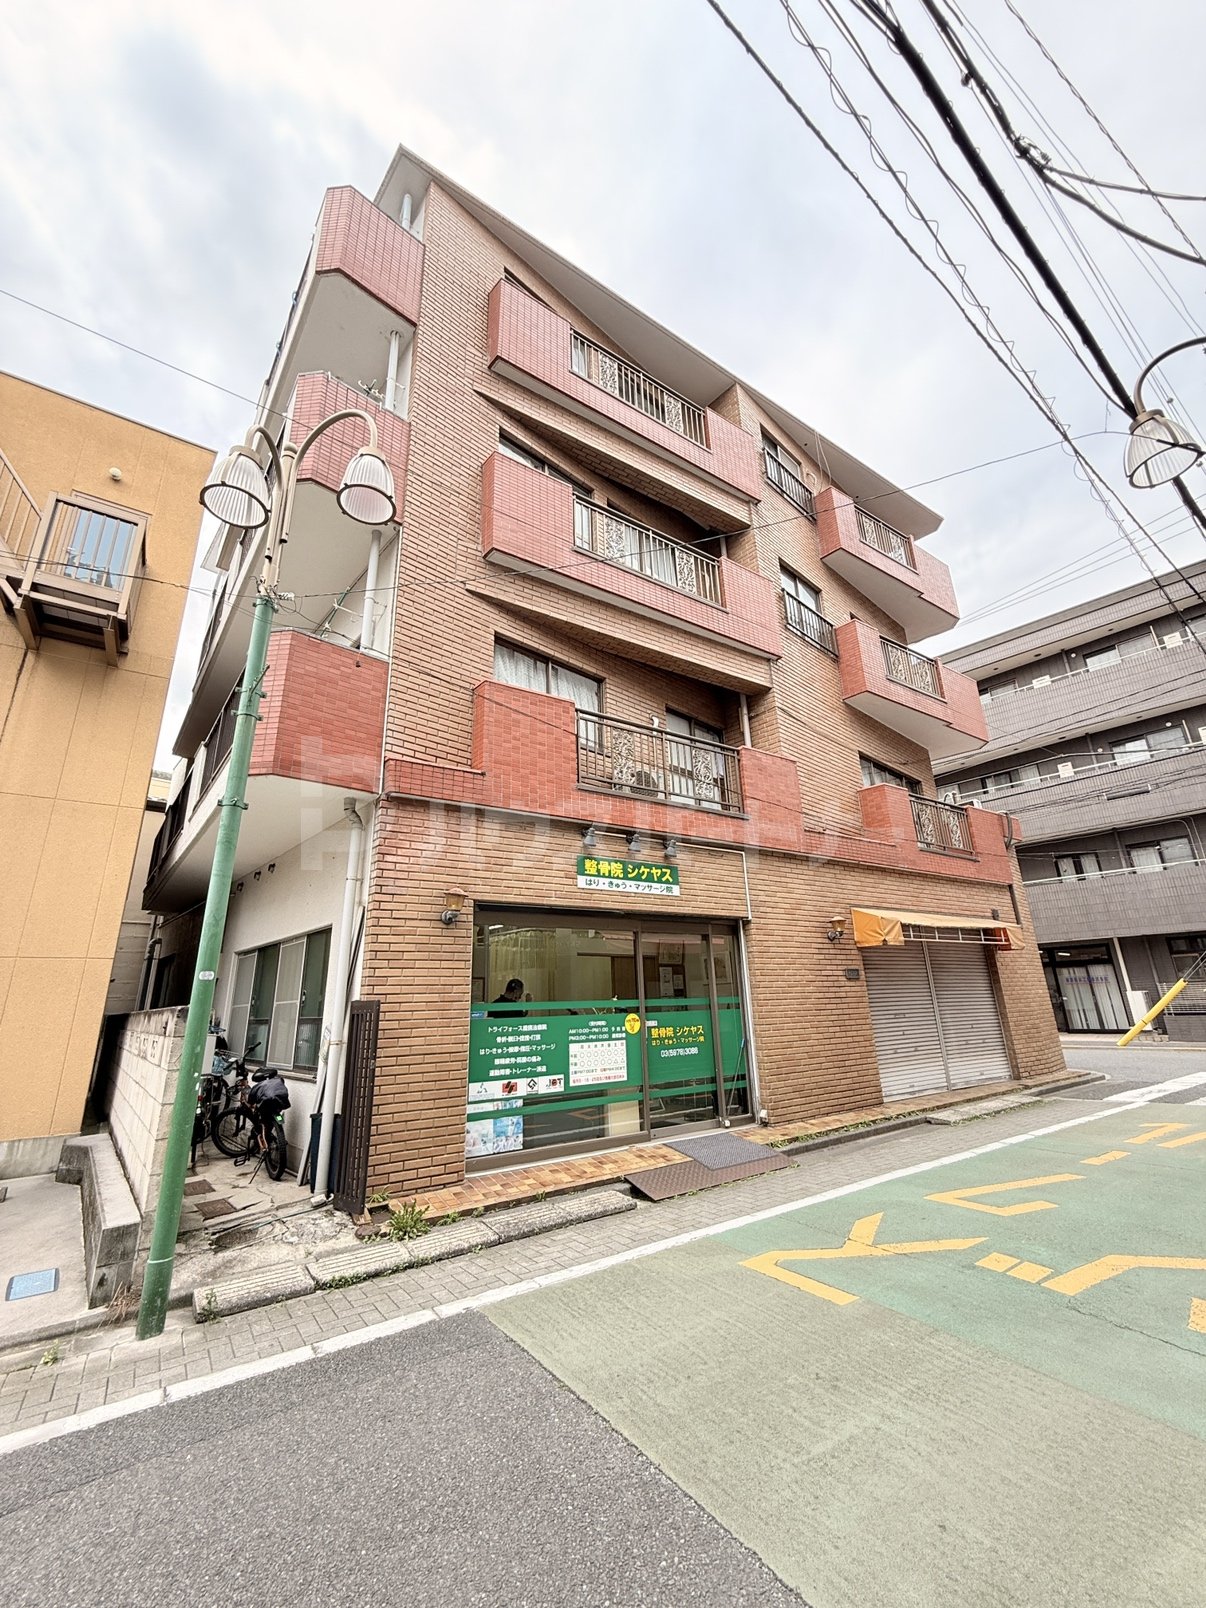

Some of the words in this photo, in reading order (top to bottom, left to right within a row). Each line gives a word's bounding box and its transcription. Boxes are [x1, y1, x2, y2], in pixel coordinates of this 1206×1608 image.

[584, 859, 624, 878] 整骨院
[627, 864, 673, 882] シケヤス
[651, 1027, 674, 1039] 整骨院
[676, 1025, 704, 1036] シケヤス
